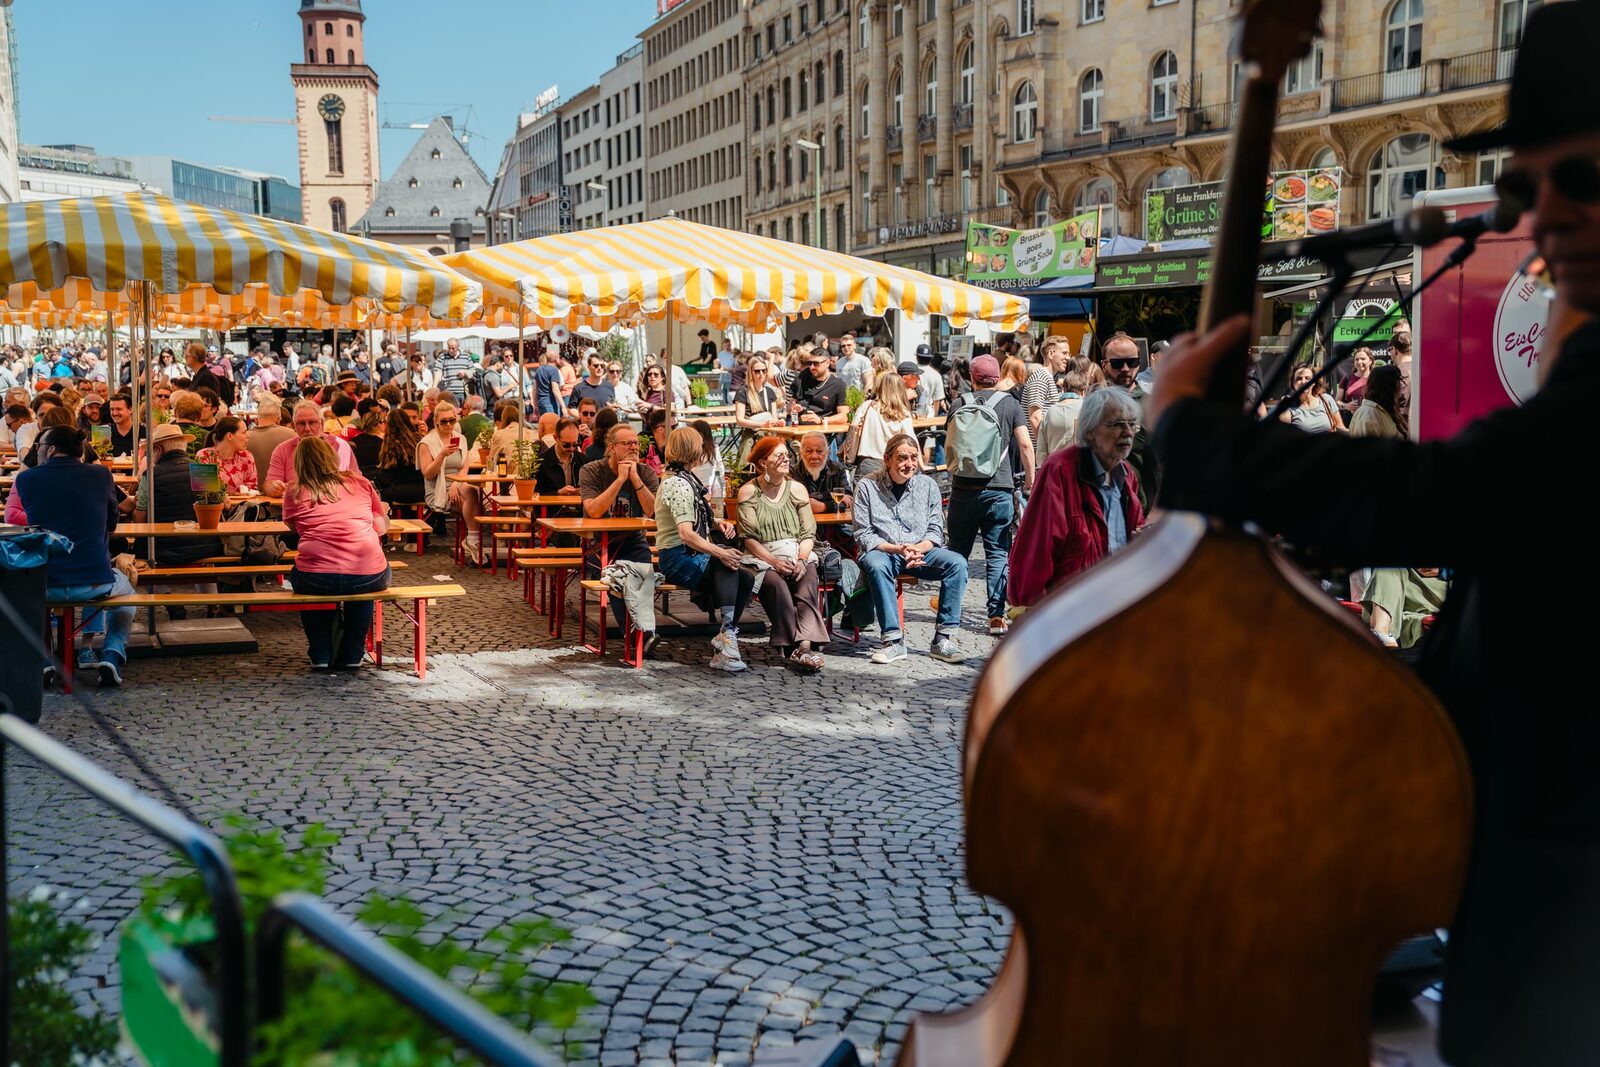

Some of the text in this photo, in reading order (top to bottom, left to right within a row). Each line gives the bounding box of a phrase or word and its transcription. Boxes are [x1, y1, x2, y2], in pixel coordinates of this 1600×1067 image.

[1176, 193, 1192, 203] Echte
[559, 186, 571, 232] HOT
[1165, 202, 1223, 225] Grüne So
[914, 218, 954, 237] AIRLINES
[1026, 241, 1042, 255] goes
[1016, 248, 1054, 269] Grüne Soße
[1156, 261, 1187, 273] Schnittlauch
[974, 277, 1042, 290] KOREA eats better
[1153, 274, 1169, 283] Kresse
[1340, 326, 1367, 336] Echte
